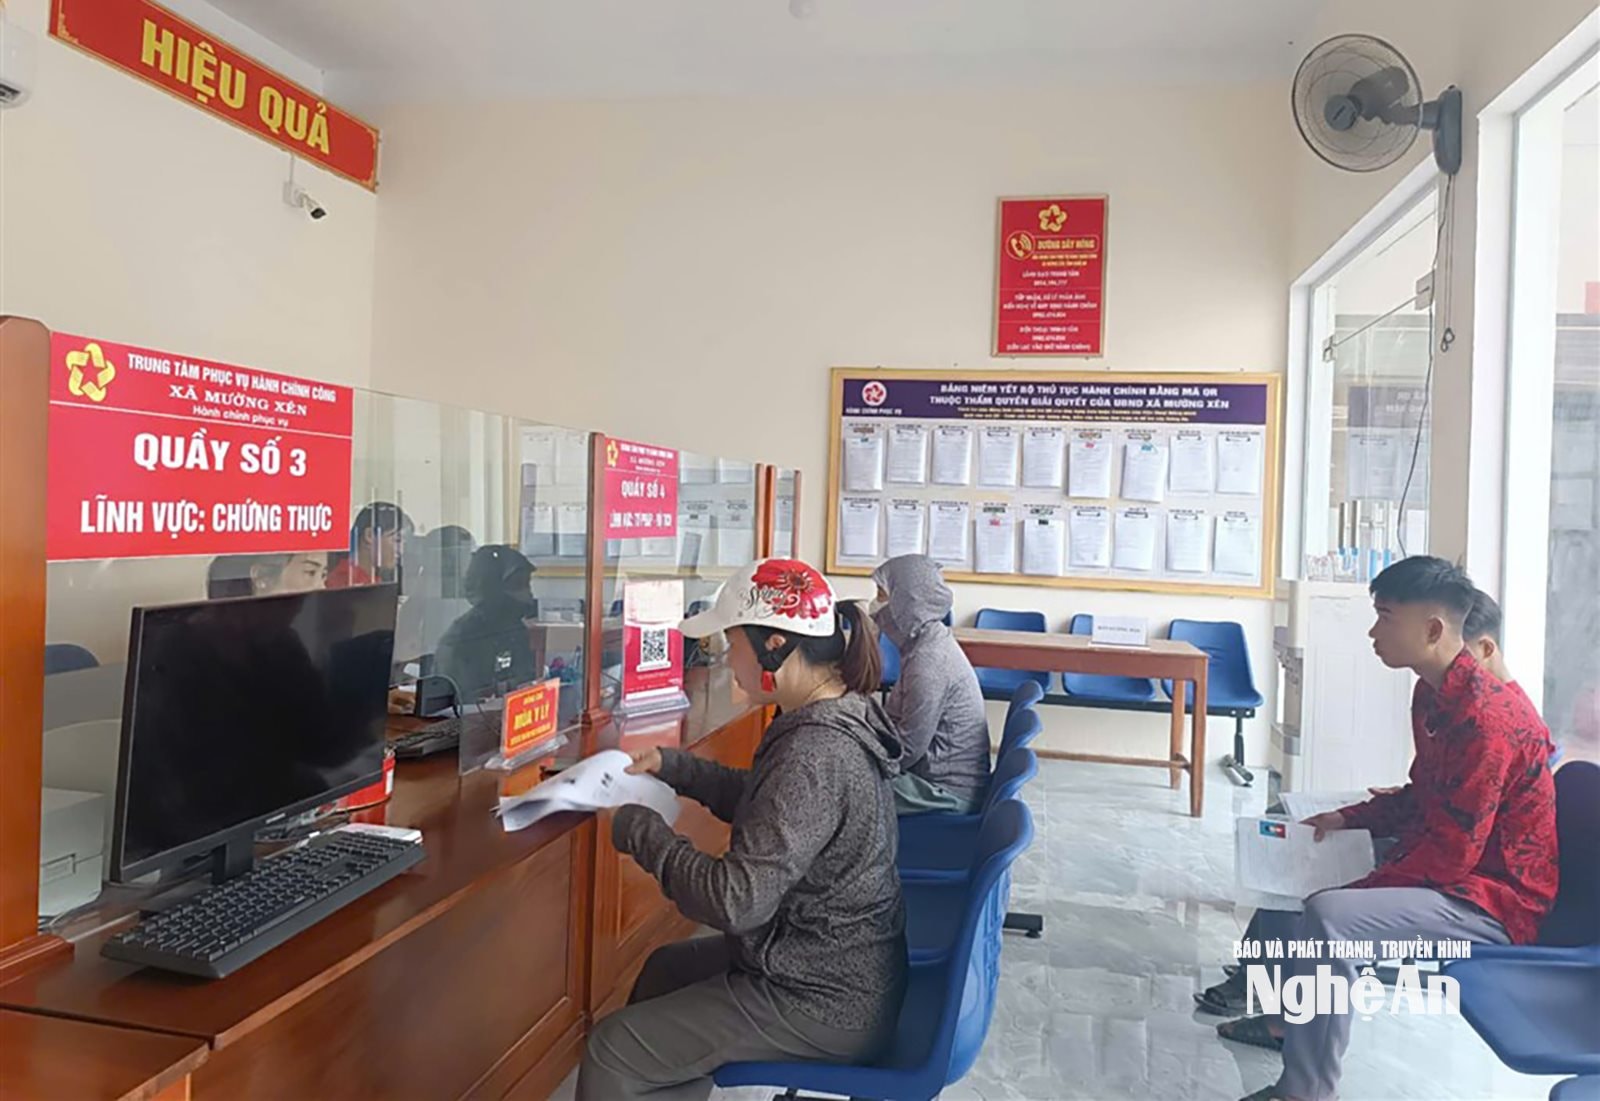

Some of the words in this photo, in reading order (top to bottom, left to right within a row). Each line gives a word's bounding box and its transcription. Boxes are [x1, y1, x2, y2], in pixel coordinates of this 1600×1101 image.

[140, 18, 246, 109] HIỆU
[259, 86, 330, 155] QUẢ
[128, 353, 171, 375] TRUNG
[174, 360, 200, 381] TÂM
[202, 367, 233, 387] PHỤC
[235, 373, 250, 389] VỤ
[251, 373, 280, 394] HÀNH
[281, 379, 310, 398] CHÍNH
[311, 384, 337, 402] CÔNG
[168, 384, 199, 401] XÃ
[204, 389, 270, 411] MƯỜNG
[192, 405, 221, 419] Hành
[223, 408, 251, 423] chính
[252, 410, 276, 426] phục
[133, 427, 230, 472] QUẦY
[239, 435, 282, 476] SỐ
[290, 448, 307, 476] 3
[80, 494, 144, 533] LĨNH
[151, 499, 206, 539] VỰC:
[212, 498, 282, 532] CHỨNG
[287, 502, 333, 538] THỰC
